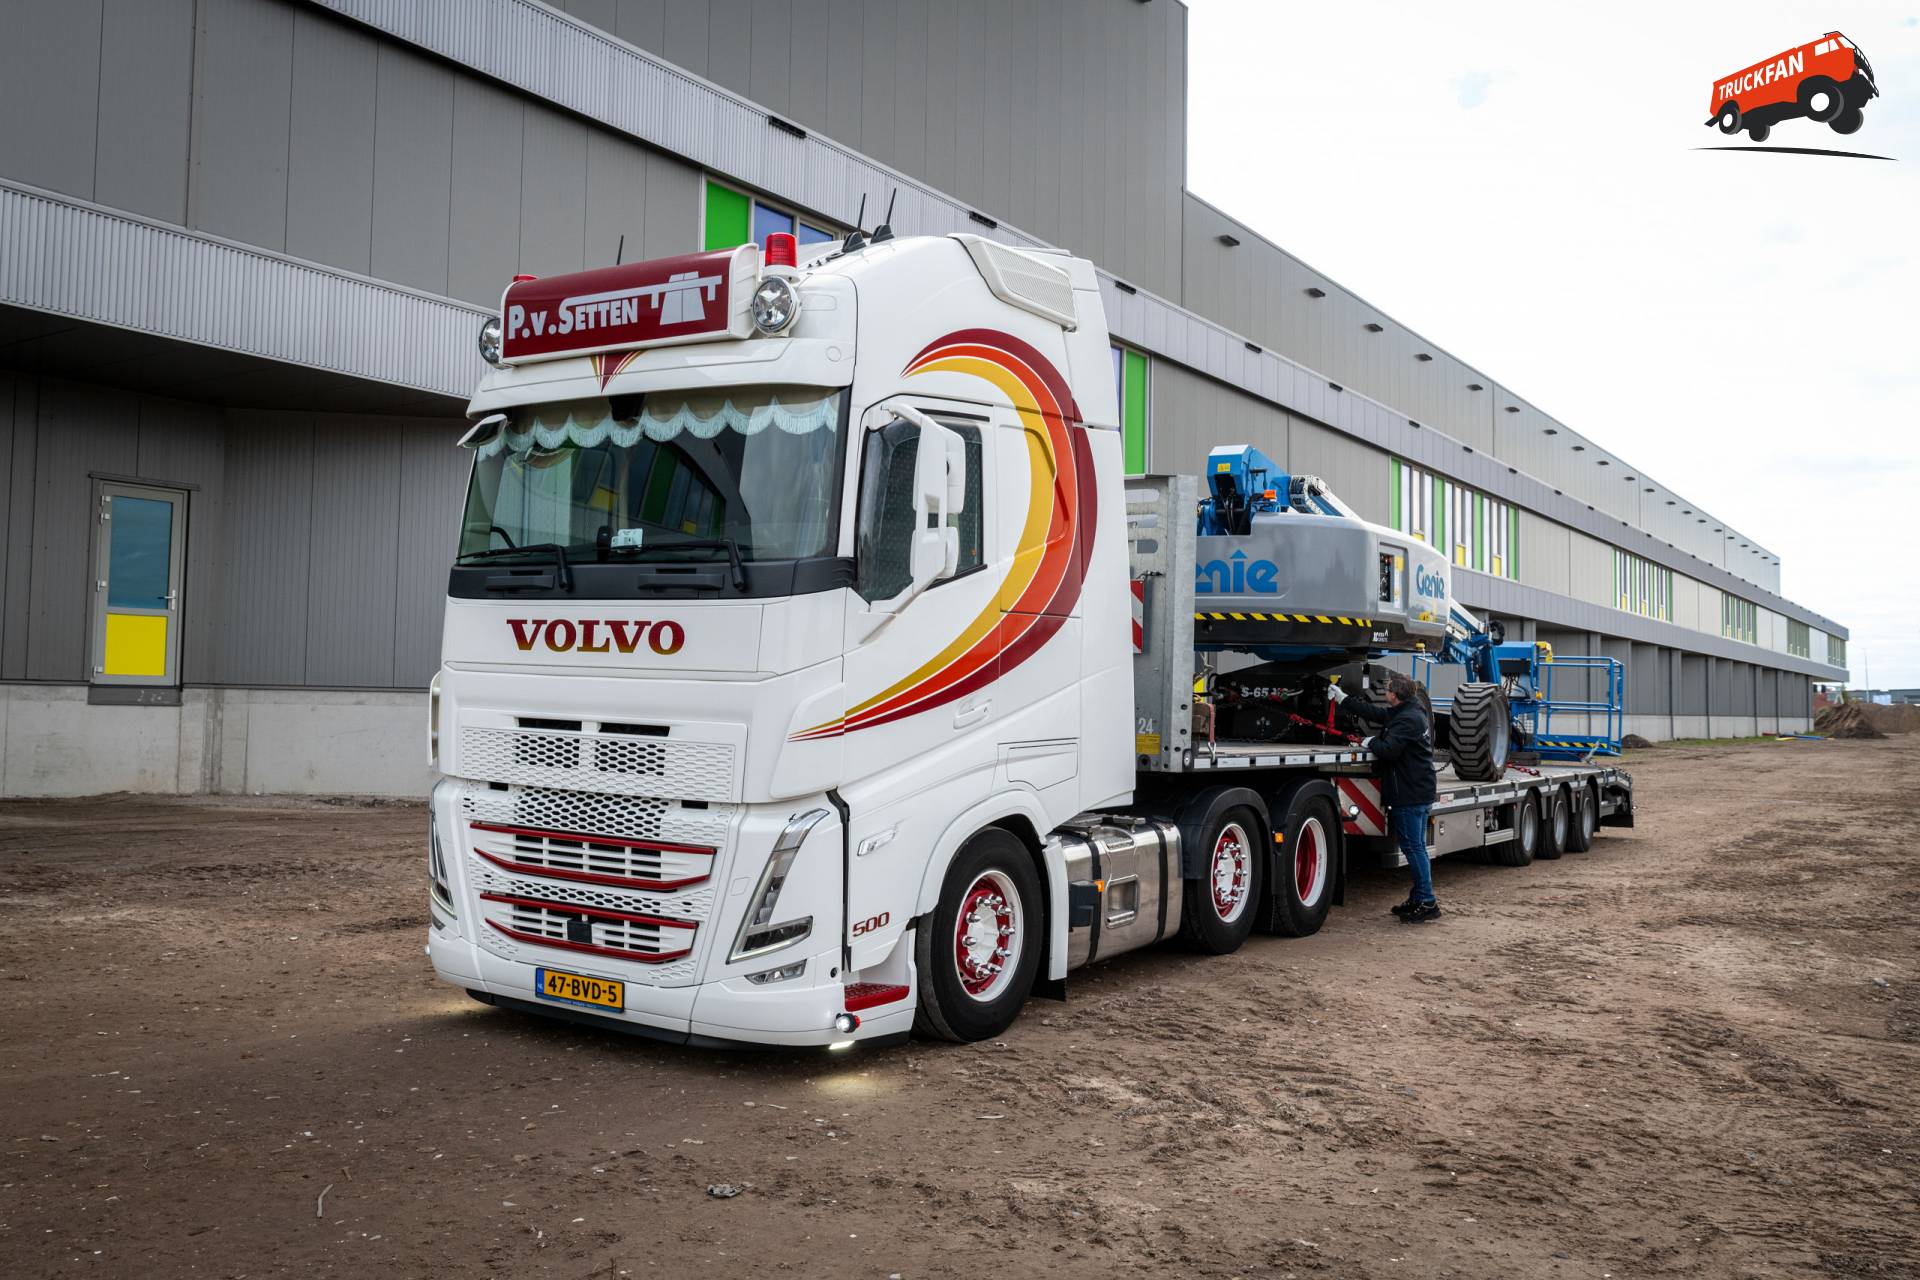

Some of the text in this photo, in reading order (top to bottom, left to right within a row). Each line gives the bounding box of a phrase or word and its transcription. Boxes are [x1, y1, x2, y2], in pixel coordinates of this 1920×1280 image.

[1416, 564, 1445, 600] Genie
[506, 618, 686, 655] VOLVO
[852, 911, 890, 937] 500
[548, 975, 617, 1003] 47-BVD-5
